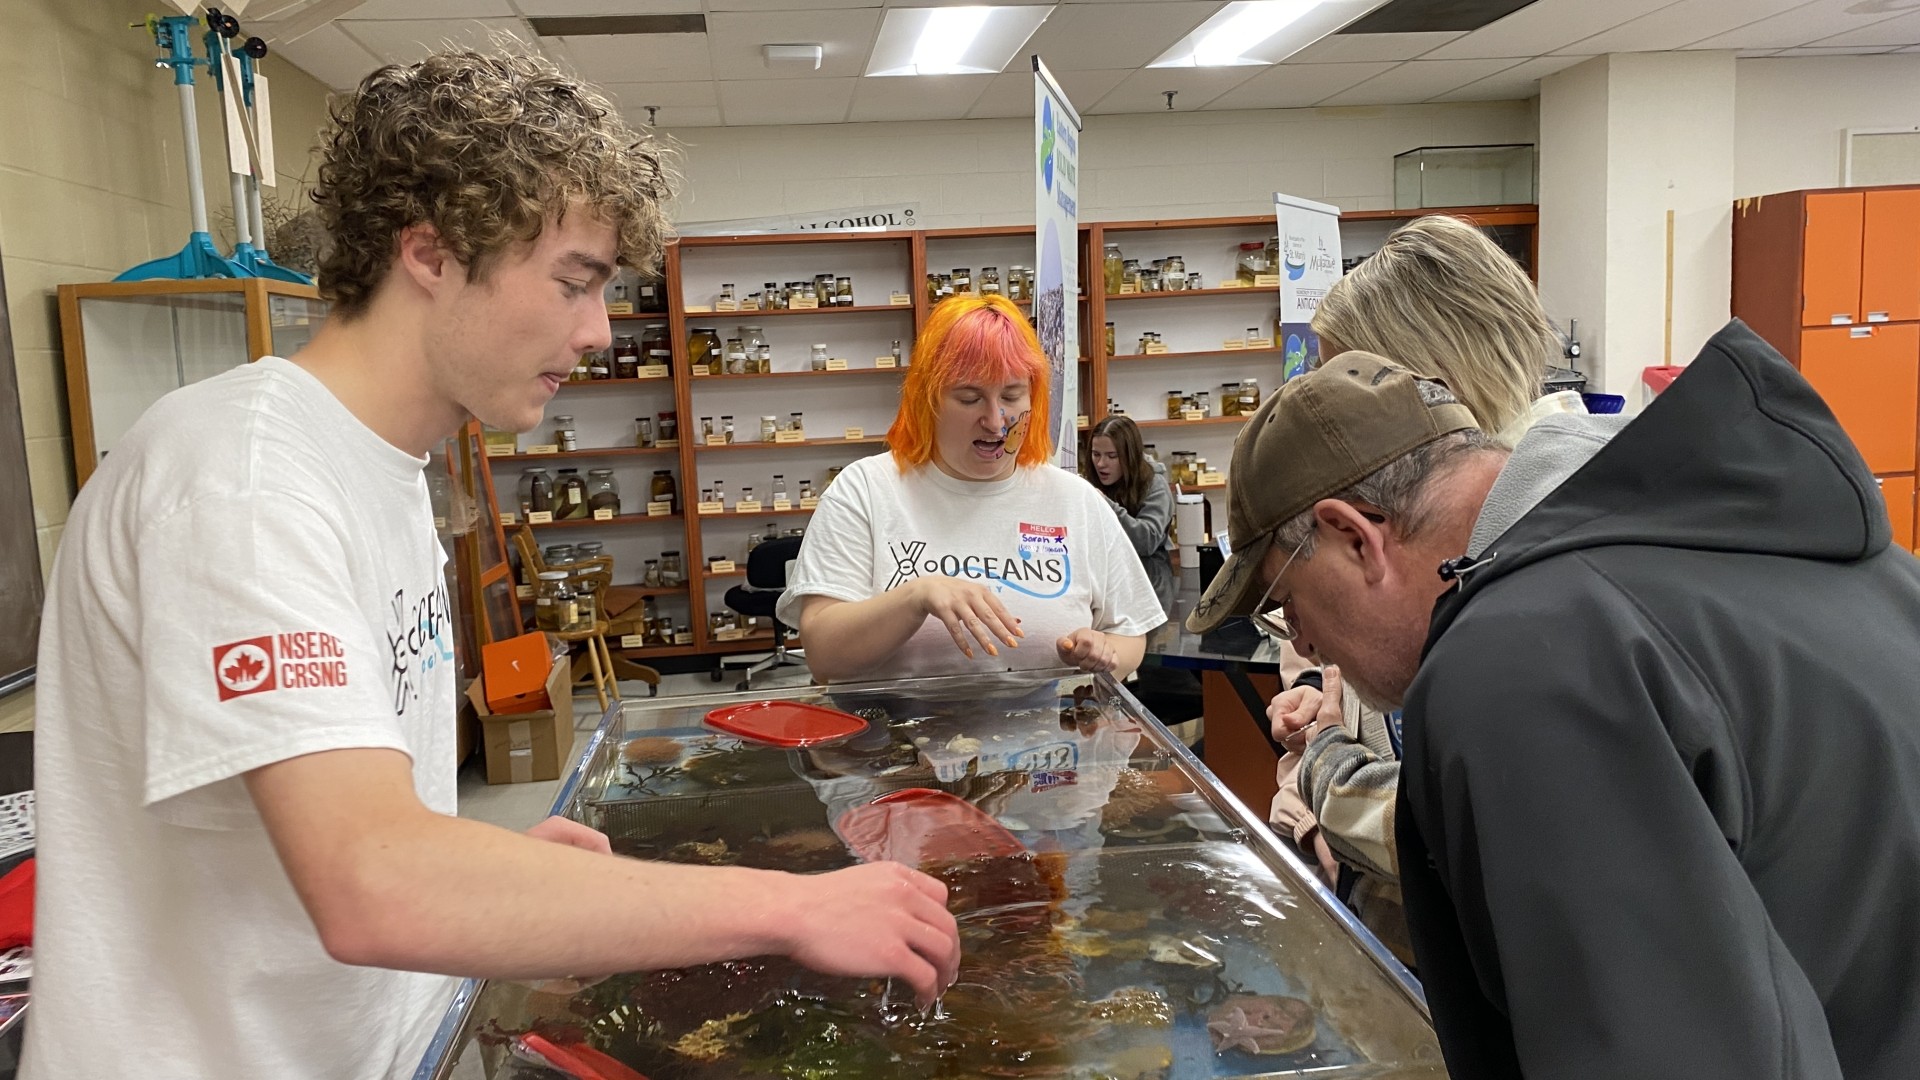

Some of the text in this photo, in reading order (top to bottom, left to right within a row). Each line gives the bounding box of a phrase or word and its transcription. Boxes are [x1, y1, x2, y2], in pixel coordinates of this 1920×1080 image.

[1022, 533, 1050, 543] Sarah
[1030, 524, 1056, 534] HELLO
[278, 631, 344, 659] NSERC
[281, 661, 347, 688] CRSNG
